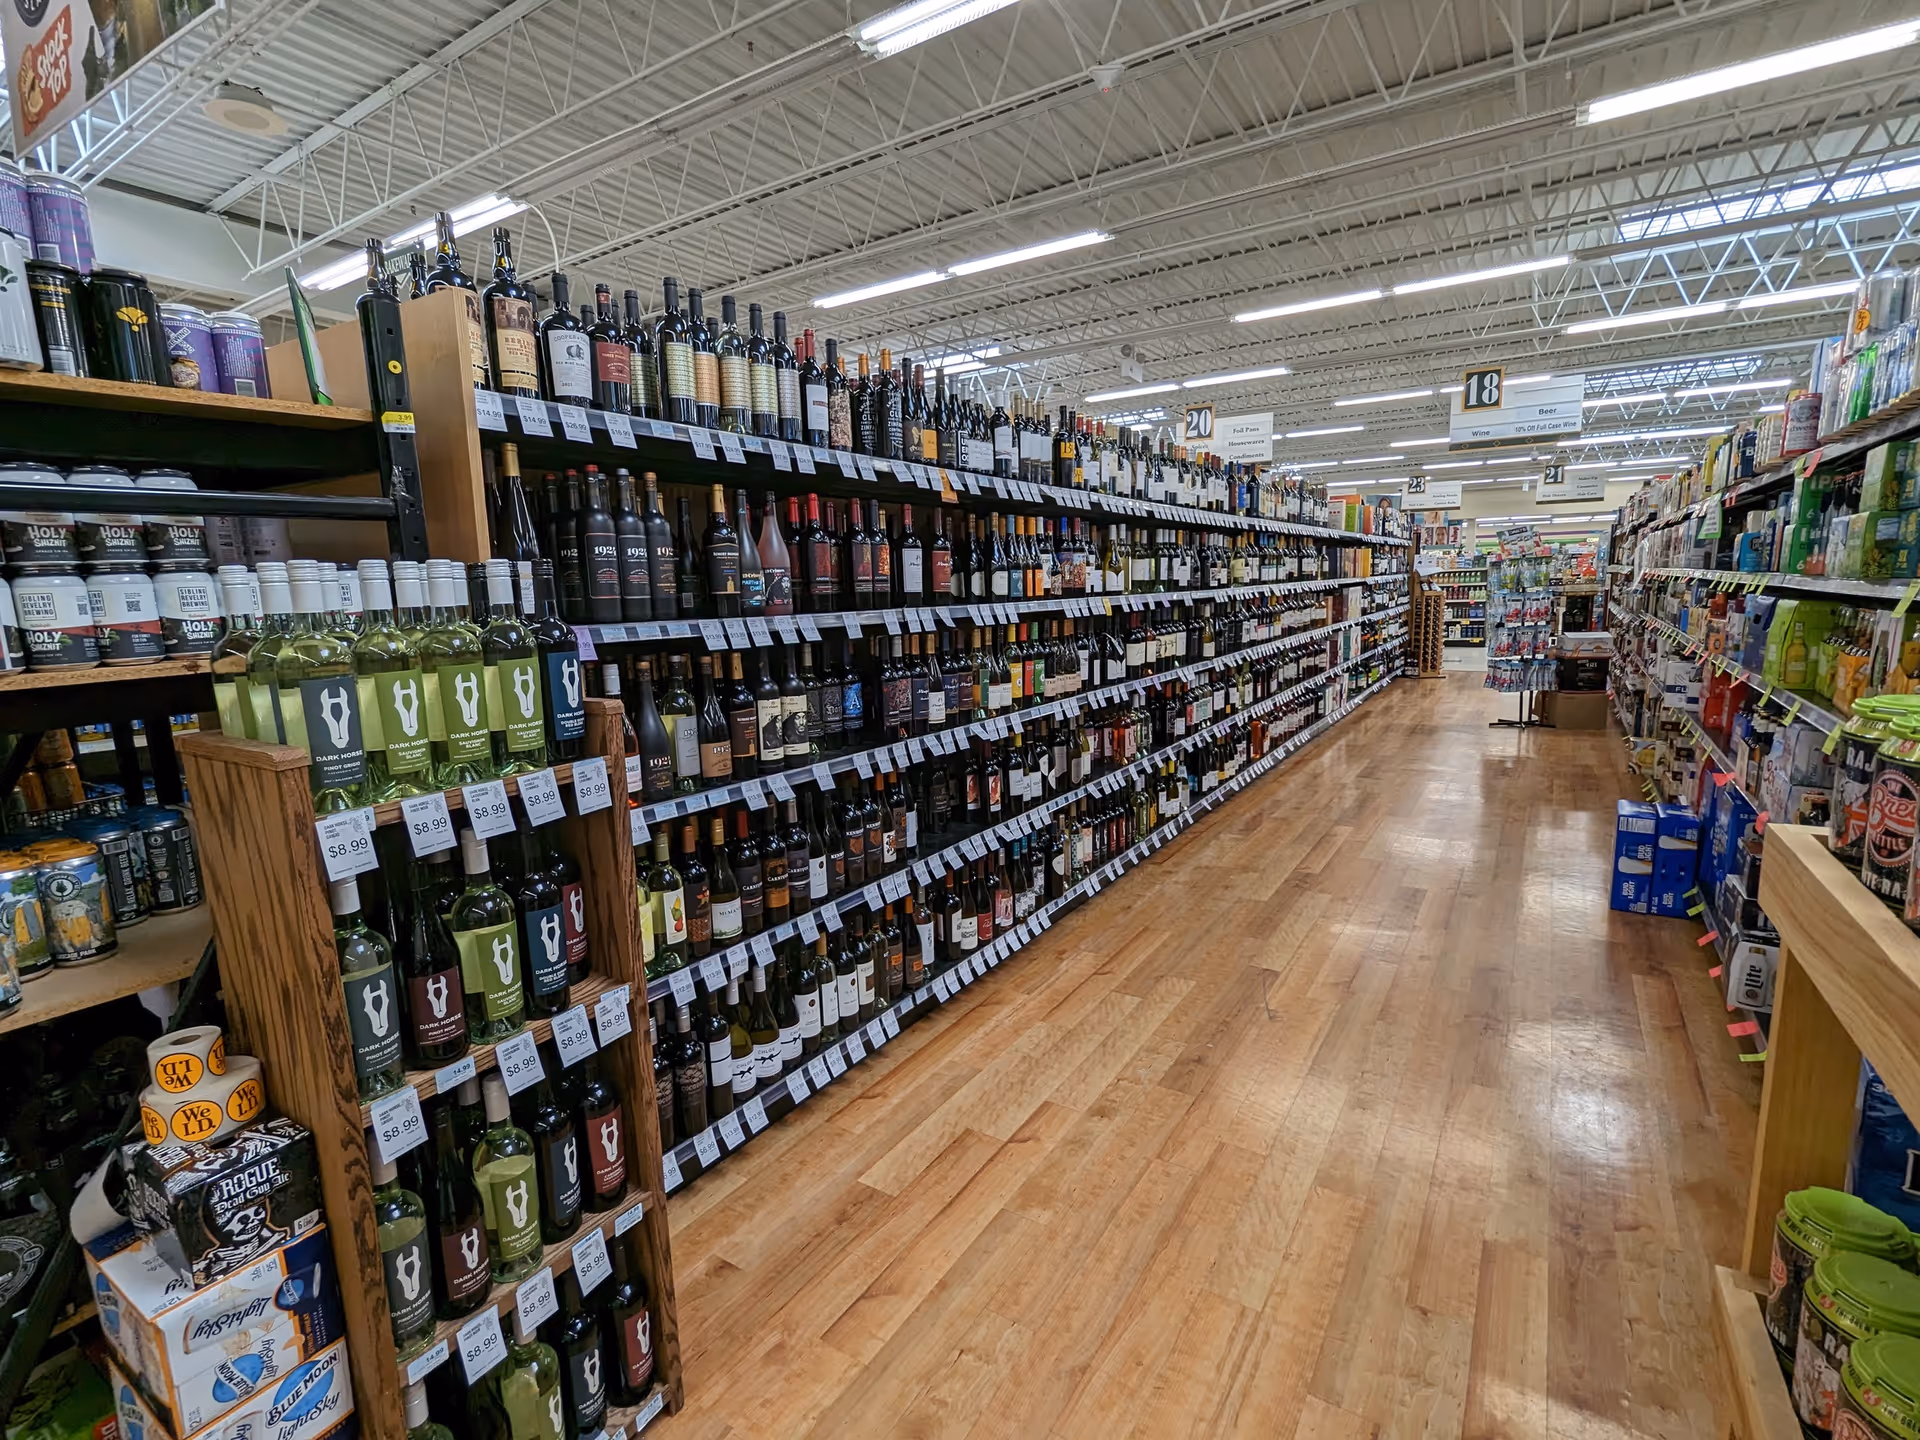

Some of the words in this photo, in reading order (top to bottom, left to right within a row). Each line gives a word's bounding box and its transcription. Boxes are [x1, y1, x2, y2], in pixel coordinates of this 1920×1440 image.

[37, 17, 68, 89] SHOCK
[47, 54, 67, 103] TOP
[553, 334, 577, 342] COOPER
[1466, 372, 1499, 406] 18
[477, 407, 502, 419] $14.99
[523, 415, 547, 425] $14.99
[1186, 409, 1212, 437] 20
[1515, 425, 1526, 433] 10%
[1527, 424, 1536, 432] Off
[1536, 423, 1547, 431] Full
[1548, 422, 1562, 430] Case
[1563, 420, 1577, 428] Wine
[1471, 429, 1490, 437] Wine
[1228, 439, 1264, 447] Housewares
[1546, 466, 1562, 483] 21
[1408, 476, 1425, 492] 23
[27, 526, 66, 539] HOLY
[100, 526, 135, 539] HOLY
[168, 526, 200, 539] HOLY
[33, 538, 67, 547] SHIZNIT
[105, 538, 135, 547] SHIZNIT
[173, 537, 200, 547] SHIZNIT
[1796, 560, 1805, 570] 6
[180, 587, 206, 595] SIBLING
[21, 595, 51, 603] SIBLING
[182, 621, 214, 632] HOLY
[26, 631, 62, 643] HOLY
[187, 631, 214, 640] SHIZNIT
[30, 643, 61, 651] SHIZNIT
[470, 728, 489, 737] HORSE
[509, 722, 527, 730] DARK
[528, 720, 543, 728] HORSE
[517, 728, 541, 736] SAUVIGNON
[389, 742, 411, 750] DARK
[411, 738, 429, 747] HORSE
[459, 738, 486, 746] SAUVIGNON
[316, 754, 340, 762] DARK
[341, 749, 363, 759] HORSE
[398, 748, 426, 757] SAUVIGNON
[405, 752, 422, 760] BLANC
[1846, 747, 1876, 773] RAJ
[343, 761, 361, 769] GRIGIO
[580, 782, 606, 799] $8.99
[1886, 780, 1902, 793] THE
[527, 790, 556, 807] $8.99
[473, 802, 506, 820] $8.99
[1872, 787, 1920, 830] Bre
[413, 816, 447, 836] $8.99
[328, 837, 368, 859] $8.99
[1637, 844, 1645, 860] BUD
[1645, 844, 1653, 862] LIGHT
[1628, 880, 1636, 899] LIGHT
[80, 948, 97, 957] PARK
[535, 965, 553, 975] DARK
[552, 960, 568, 971] HORSE
[1745, 964, 1763, 989] Lite
[489, 990, 507, 999] DARK
[508, 981, 522, 994] HORSE
[675, 982, 693, 995] $12.99
[419, 1021, 440, 1030] DARK
[440, 1012, 462, 1026] HORSE
[444, 1024, 456, 1032] NOIR
[600, 1011, 626, 1032] $8.99
[358, 1042, 381, 1054] DARK
[381, 1031, 400, 1046] HORSE
[560, 1029, 588, 1050] $8.99
[366, 1051, 383, 1061] PINOT
[160, 1059, 193, 1074] I.D.
[453, 1063, 471, 1076] 14.99
[506, 1055, 537, 1077] $8.99
[165, 1074, 193, 1089] We
[235, 1083, 256, 1101] We
[181, 1105, 211, 1122] We
[182, 1117, 216, 1137] I.D.
[382, 1115, 419, 1143] $8.99
[699, 1141, 715, 1156] $6.99
[221, 1157, 280, 1199] ROGUE
[596, 1166, 612, 1175] DARK
[214, 1193, 244, 1214] Dead
[271, 1170, 292, 1189] Ale
[560, 1188, 574, 1200] DARK
[298, 1220, 304, 1230] 6
[502, 1232, 520, 1242] DARK
[520, 1220, 538, 1236] HORSE
[453, 1273, 473, 1285] DARK
[473, 1258, 490, 1275] HORSE
[580, 1251, 605, 1278] $8.99
[462, 1278, 477, 1288] PINOT
[391, 1306, 412, 1317] DARK
[412, 1289, 432, 1309] HORSE
[522, 1290, 551, 1318] $8.99
[191, 1296, 272, 1340] LightSky
[426, 1347, 445, 1364] 14.99
[466, 1333, 498, 1363] $8.99
[217, 1361, 237, 1385] MOON
[234, 1378, 255, 1399] BLUE
[267, 1388, 303, 1428] BLUE
[303, 1352, 339, 1390] MOON
